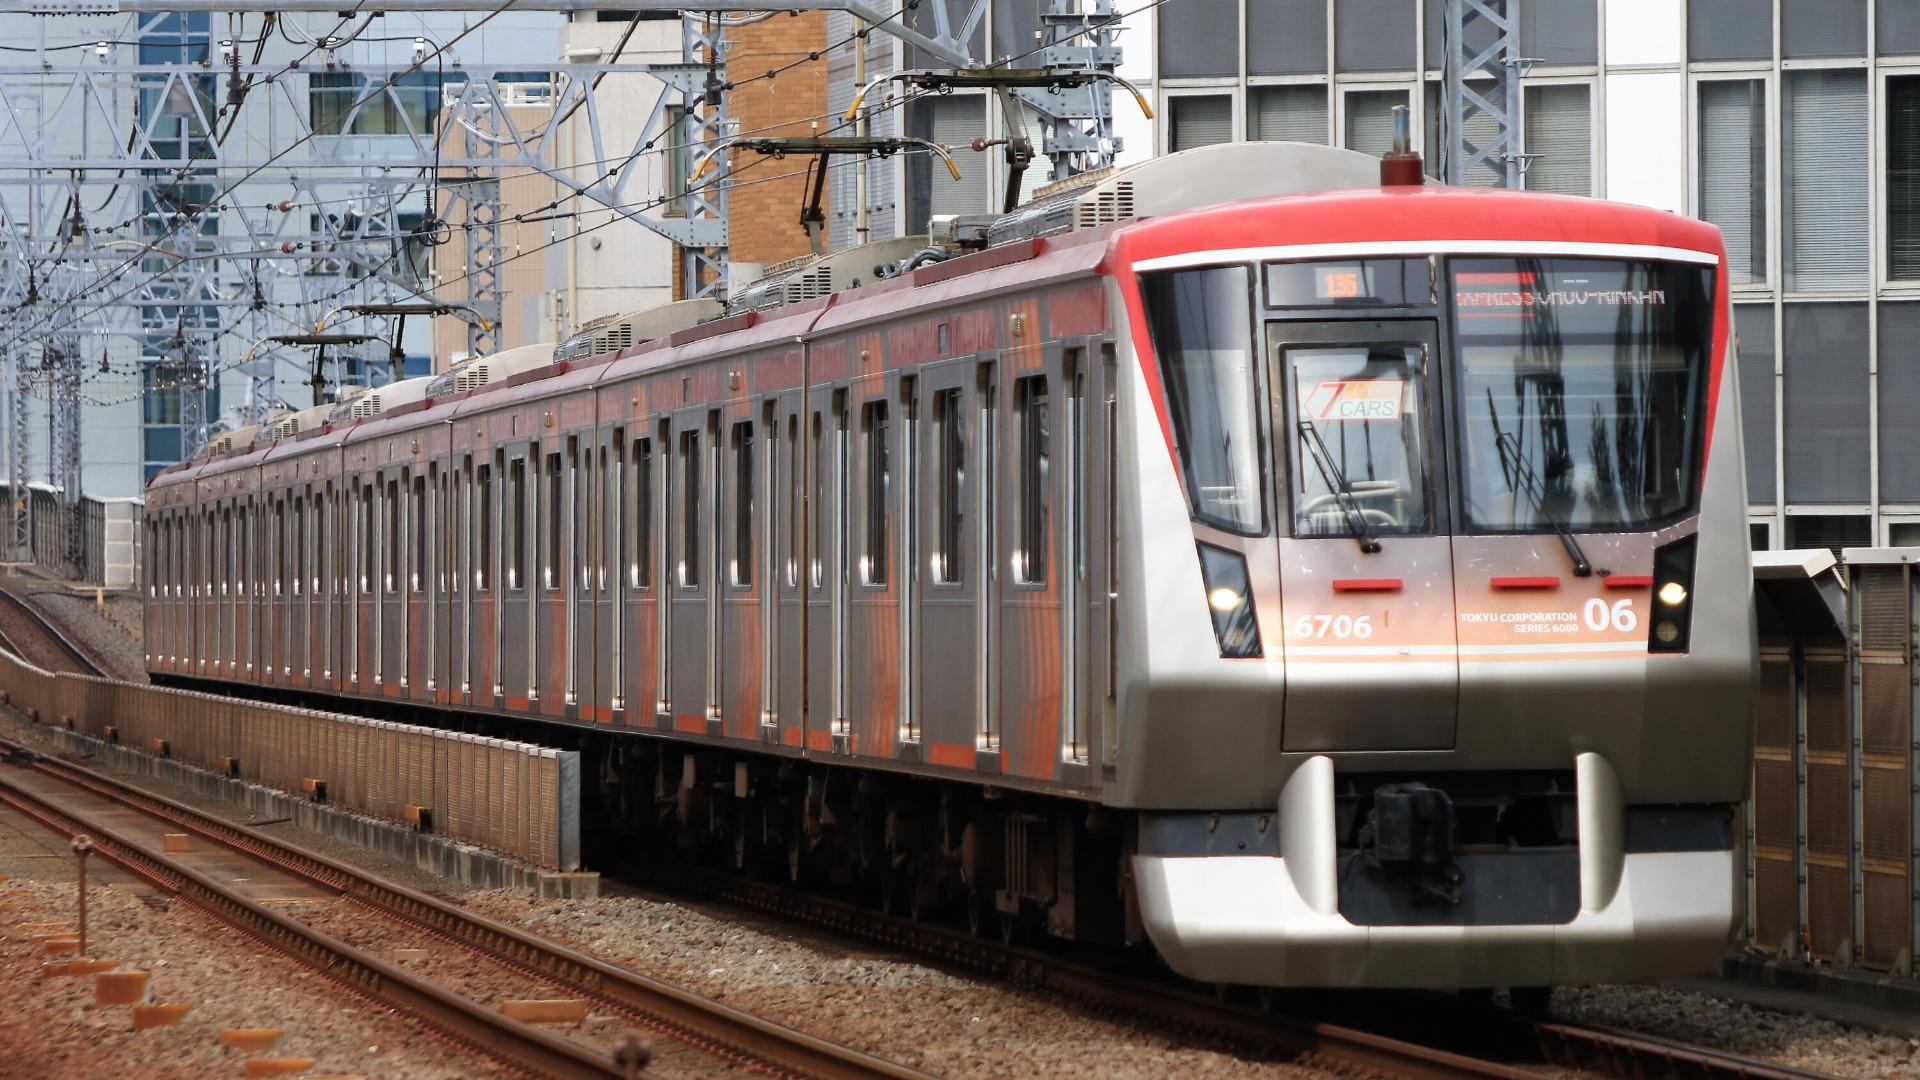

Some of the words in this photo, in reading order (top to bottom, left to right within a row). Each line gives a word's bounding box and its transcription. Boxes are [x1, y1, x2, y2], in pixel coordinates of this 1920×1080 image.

[1321, 382, 1346, 418] 7
[1340, 400, 1394, 417] CARS
[1295, 614, 1373, 639] 6706
[1460, 612, 1498, 623] TOKYU
[1500, 611, 1578, 623] CORPORATION
[1584, 597, 1638, 633] 06
[1514, 623, 1551, 633] SERIES
[1552, 623, 1579, 633] 6000
